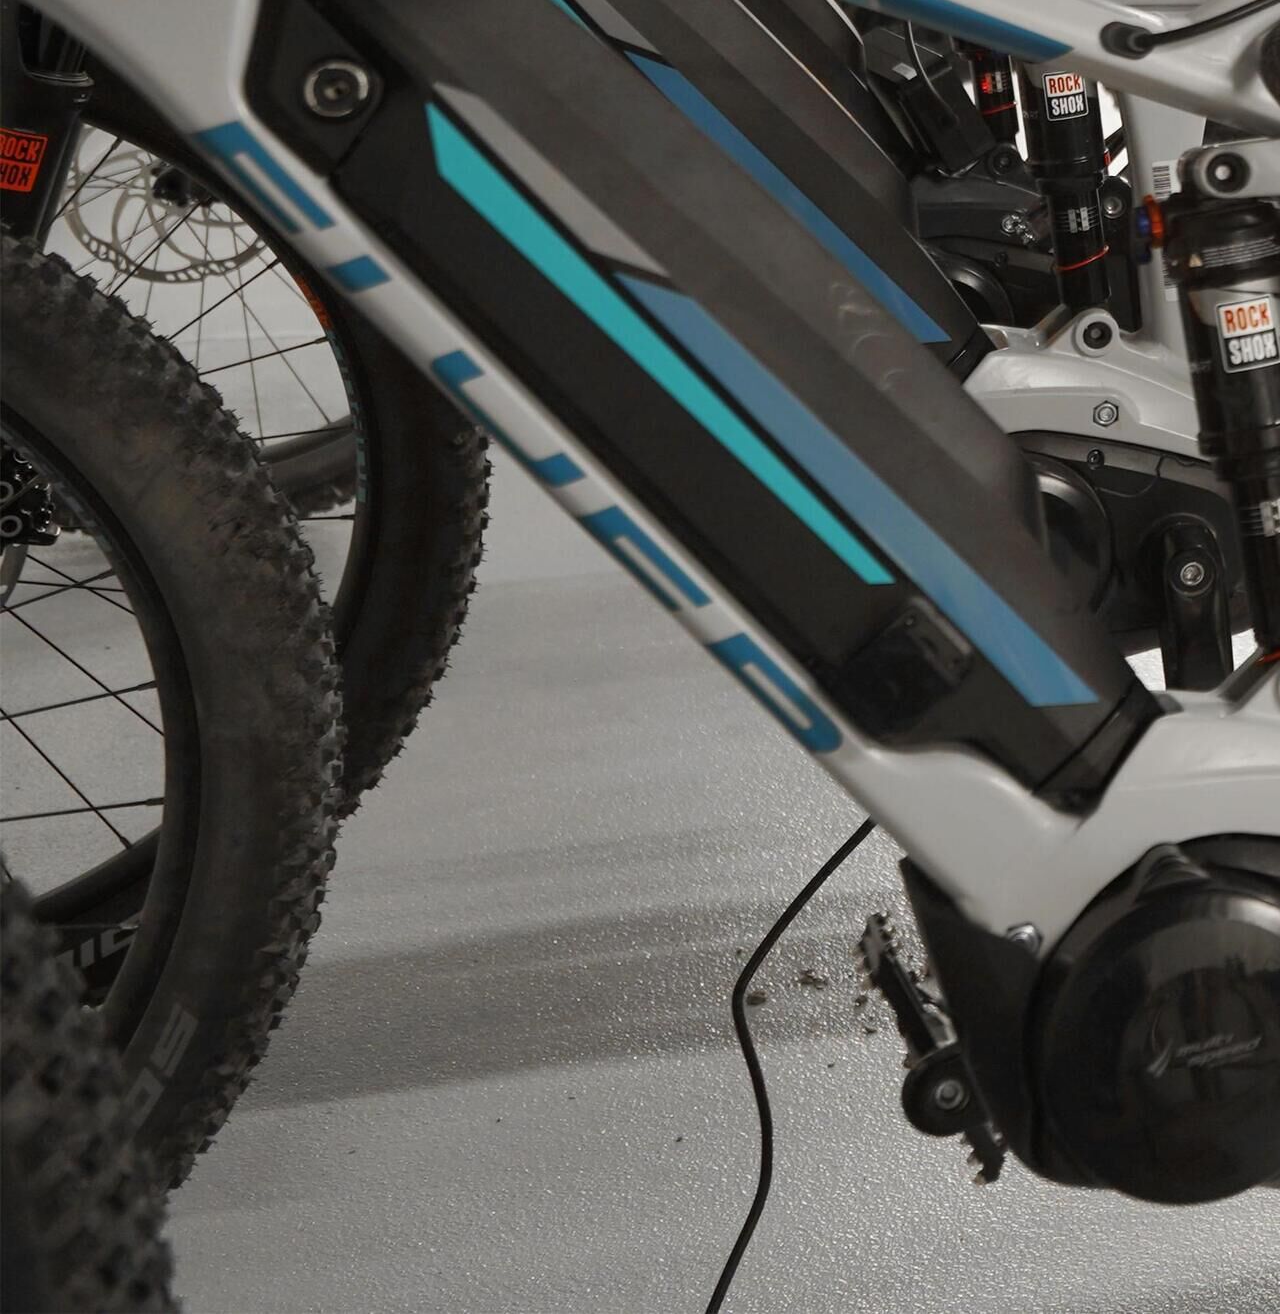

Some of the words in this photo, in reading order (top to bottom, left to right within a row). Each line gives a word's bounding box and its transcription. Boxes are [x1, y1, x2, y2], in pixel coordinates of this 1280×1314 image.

[1048, 74, 1081, 95] ROCK
[1051, 94, 1085, 116] SHOX
[0, 163, 32, 186] HOX
[1224, 302, 1271, 333] ROCK
[1228, 333, 1277, 365] SHOX
